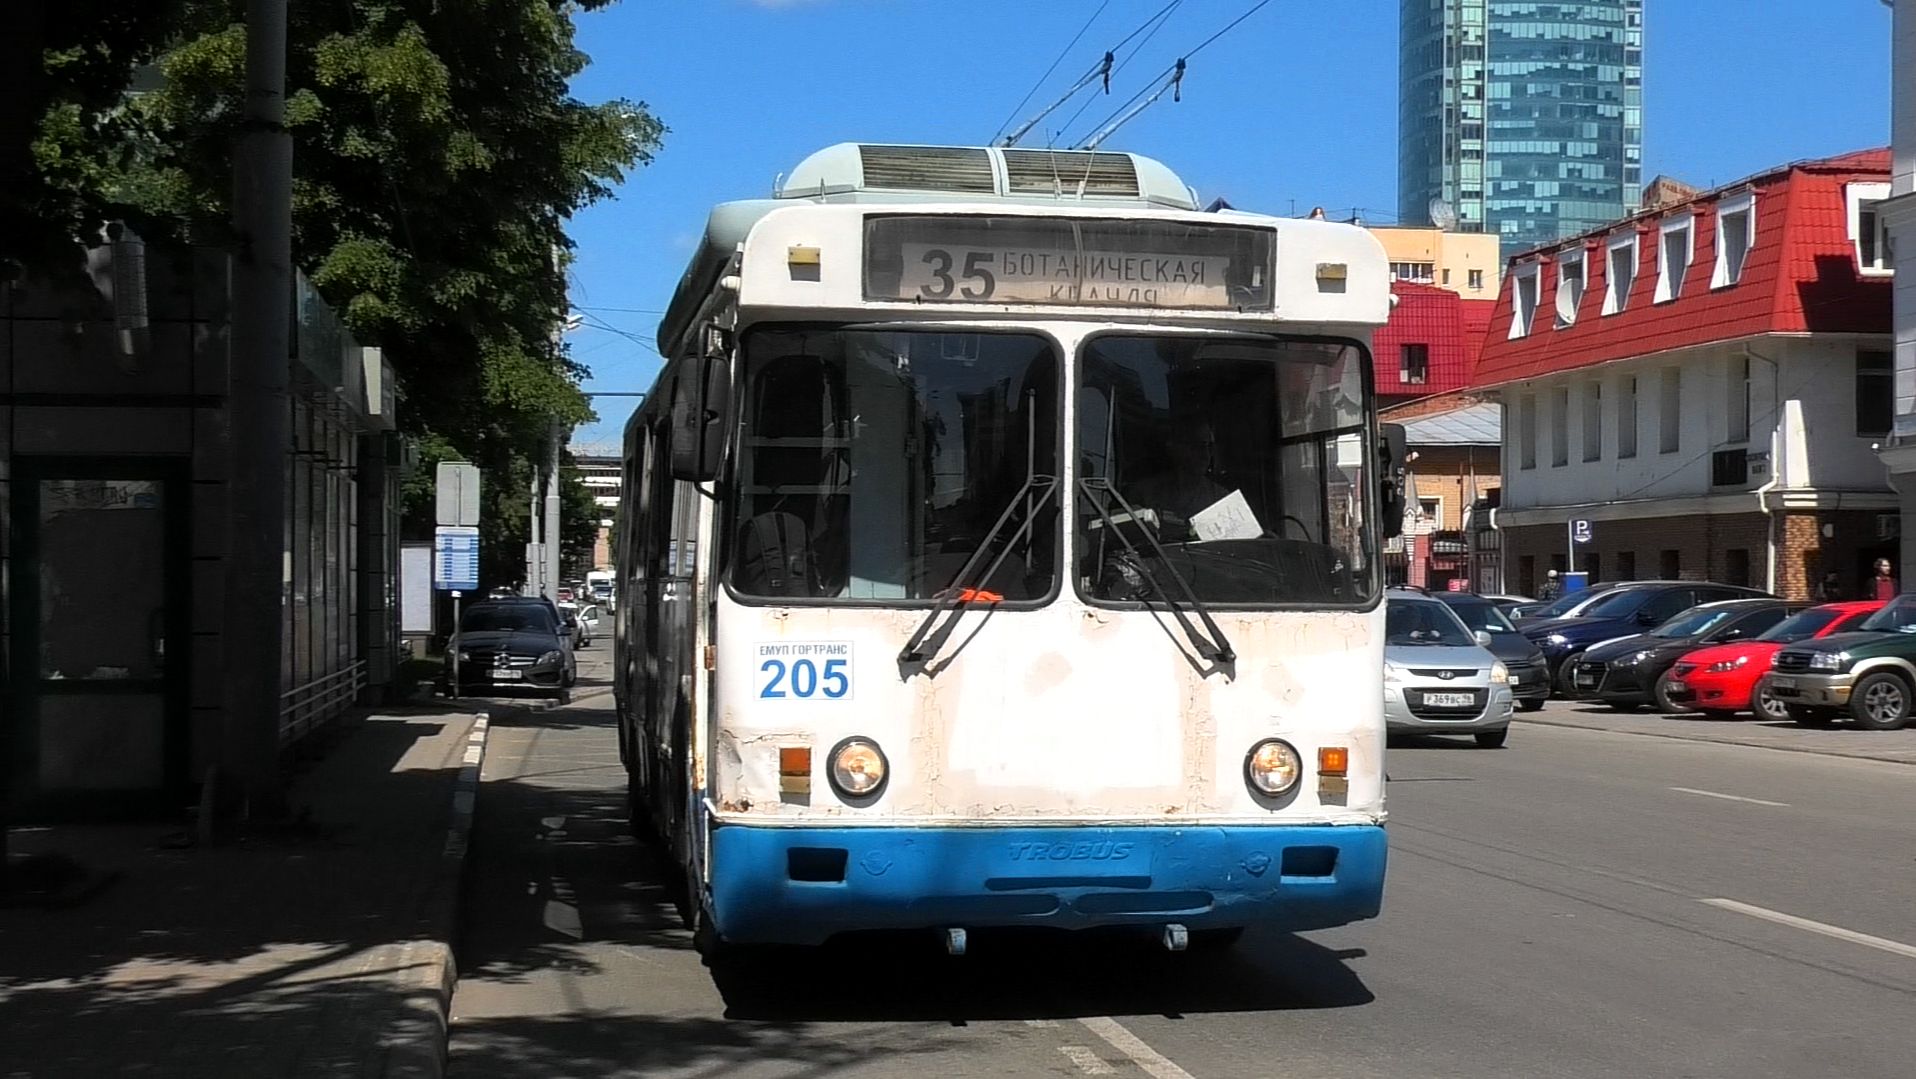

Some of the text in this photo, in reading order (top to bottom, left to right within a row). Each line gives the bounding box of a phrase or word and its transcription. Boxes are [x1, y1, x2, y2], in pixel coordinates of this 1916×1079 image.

[920, 249, 995, 300] 35
[1003, 252, 1205, 284] БОТАНИЧЕСКАЯ
[760, 644, 848, 655] ЕМУП ГОРТРАНС
[760, 659, 848, 698] 205
[1009, 842, 1134, 860] TROBUS
